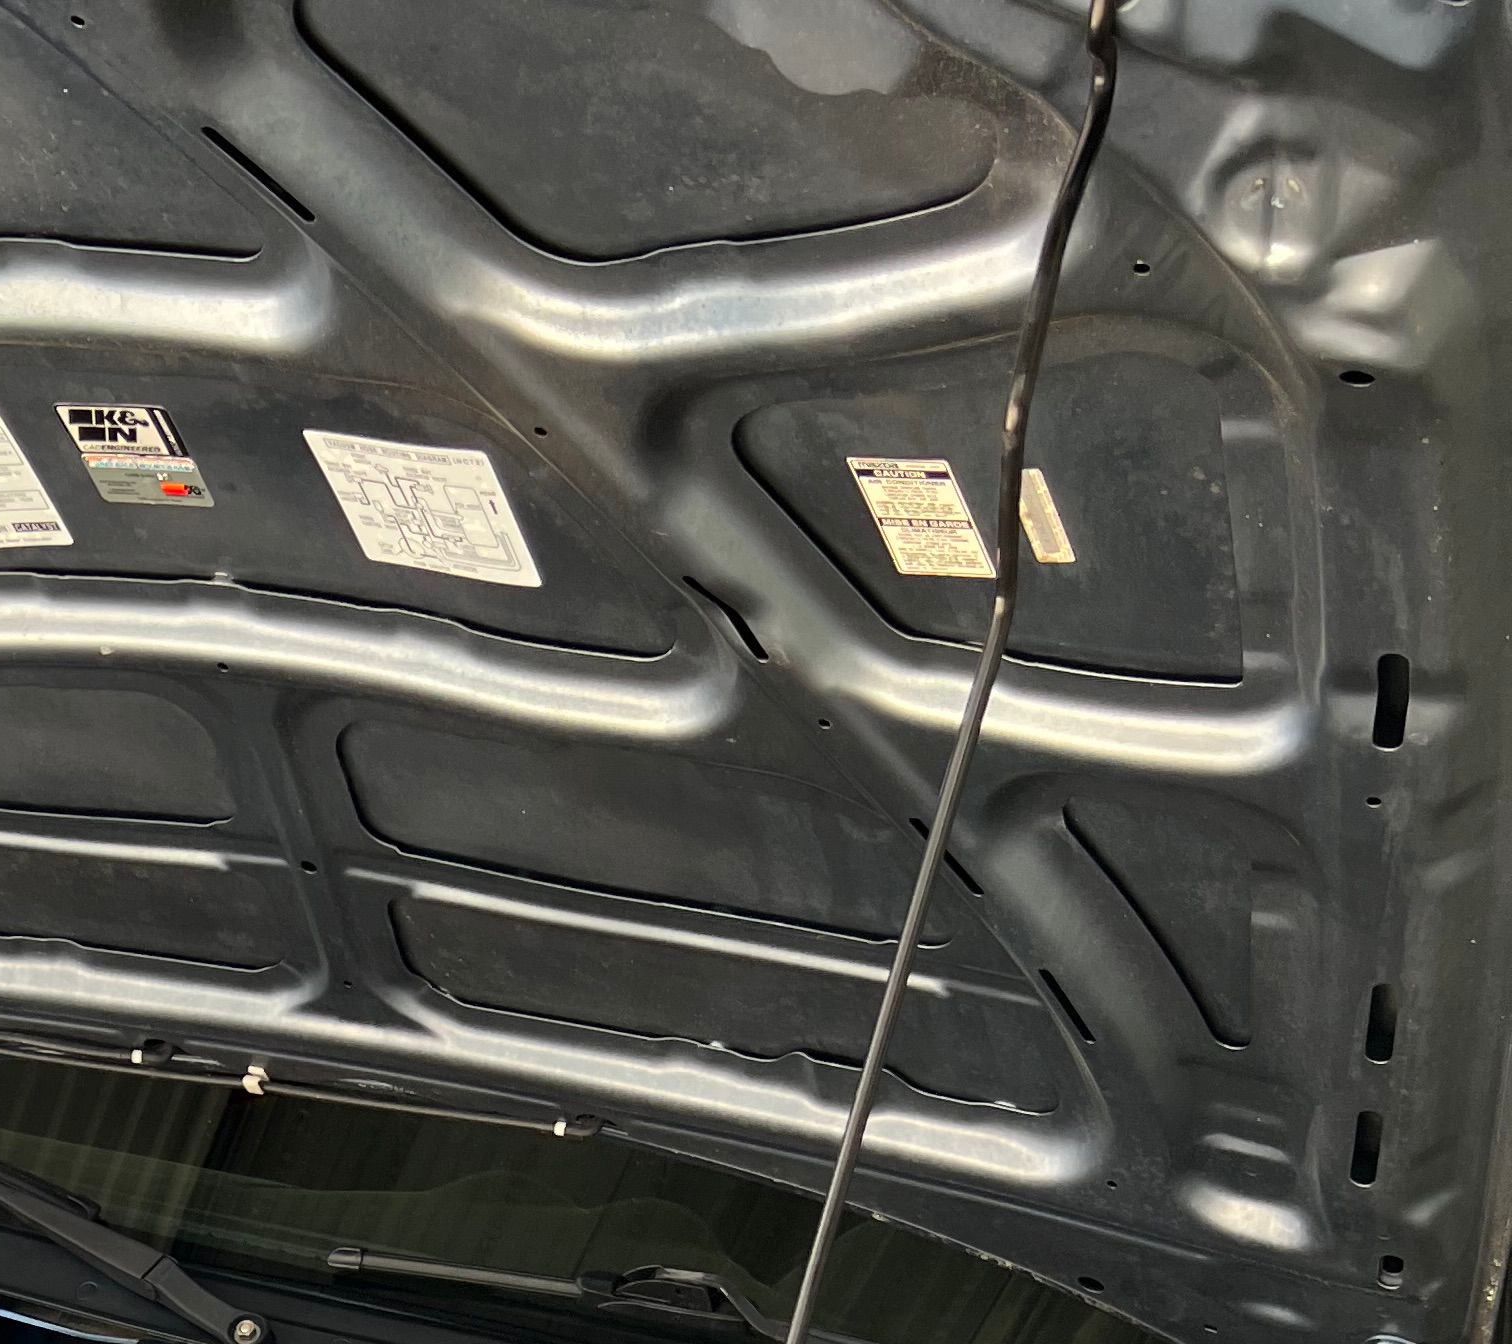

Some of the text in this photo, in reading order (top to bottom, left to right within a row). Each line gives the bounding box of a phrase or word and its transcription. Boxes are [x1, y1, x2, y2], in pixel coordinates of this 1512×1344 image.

[873, 470, 926, 478] CAUTION
[912, 519, 928, 527] EN
[13, 522, 61, 533] CATALYST
